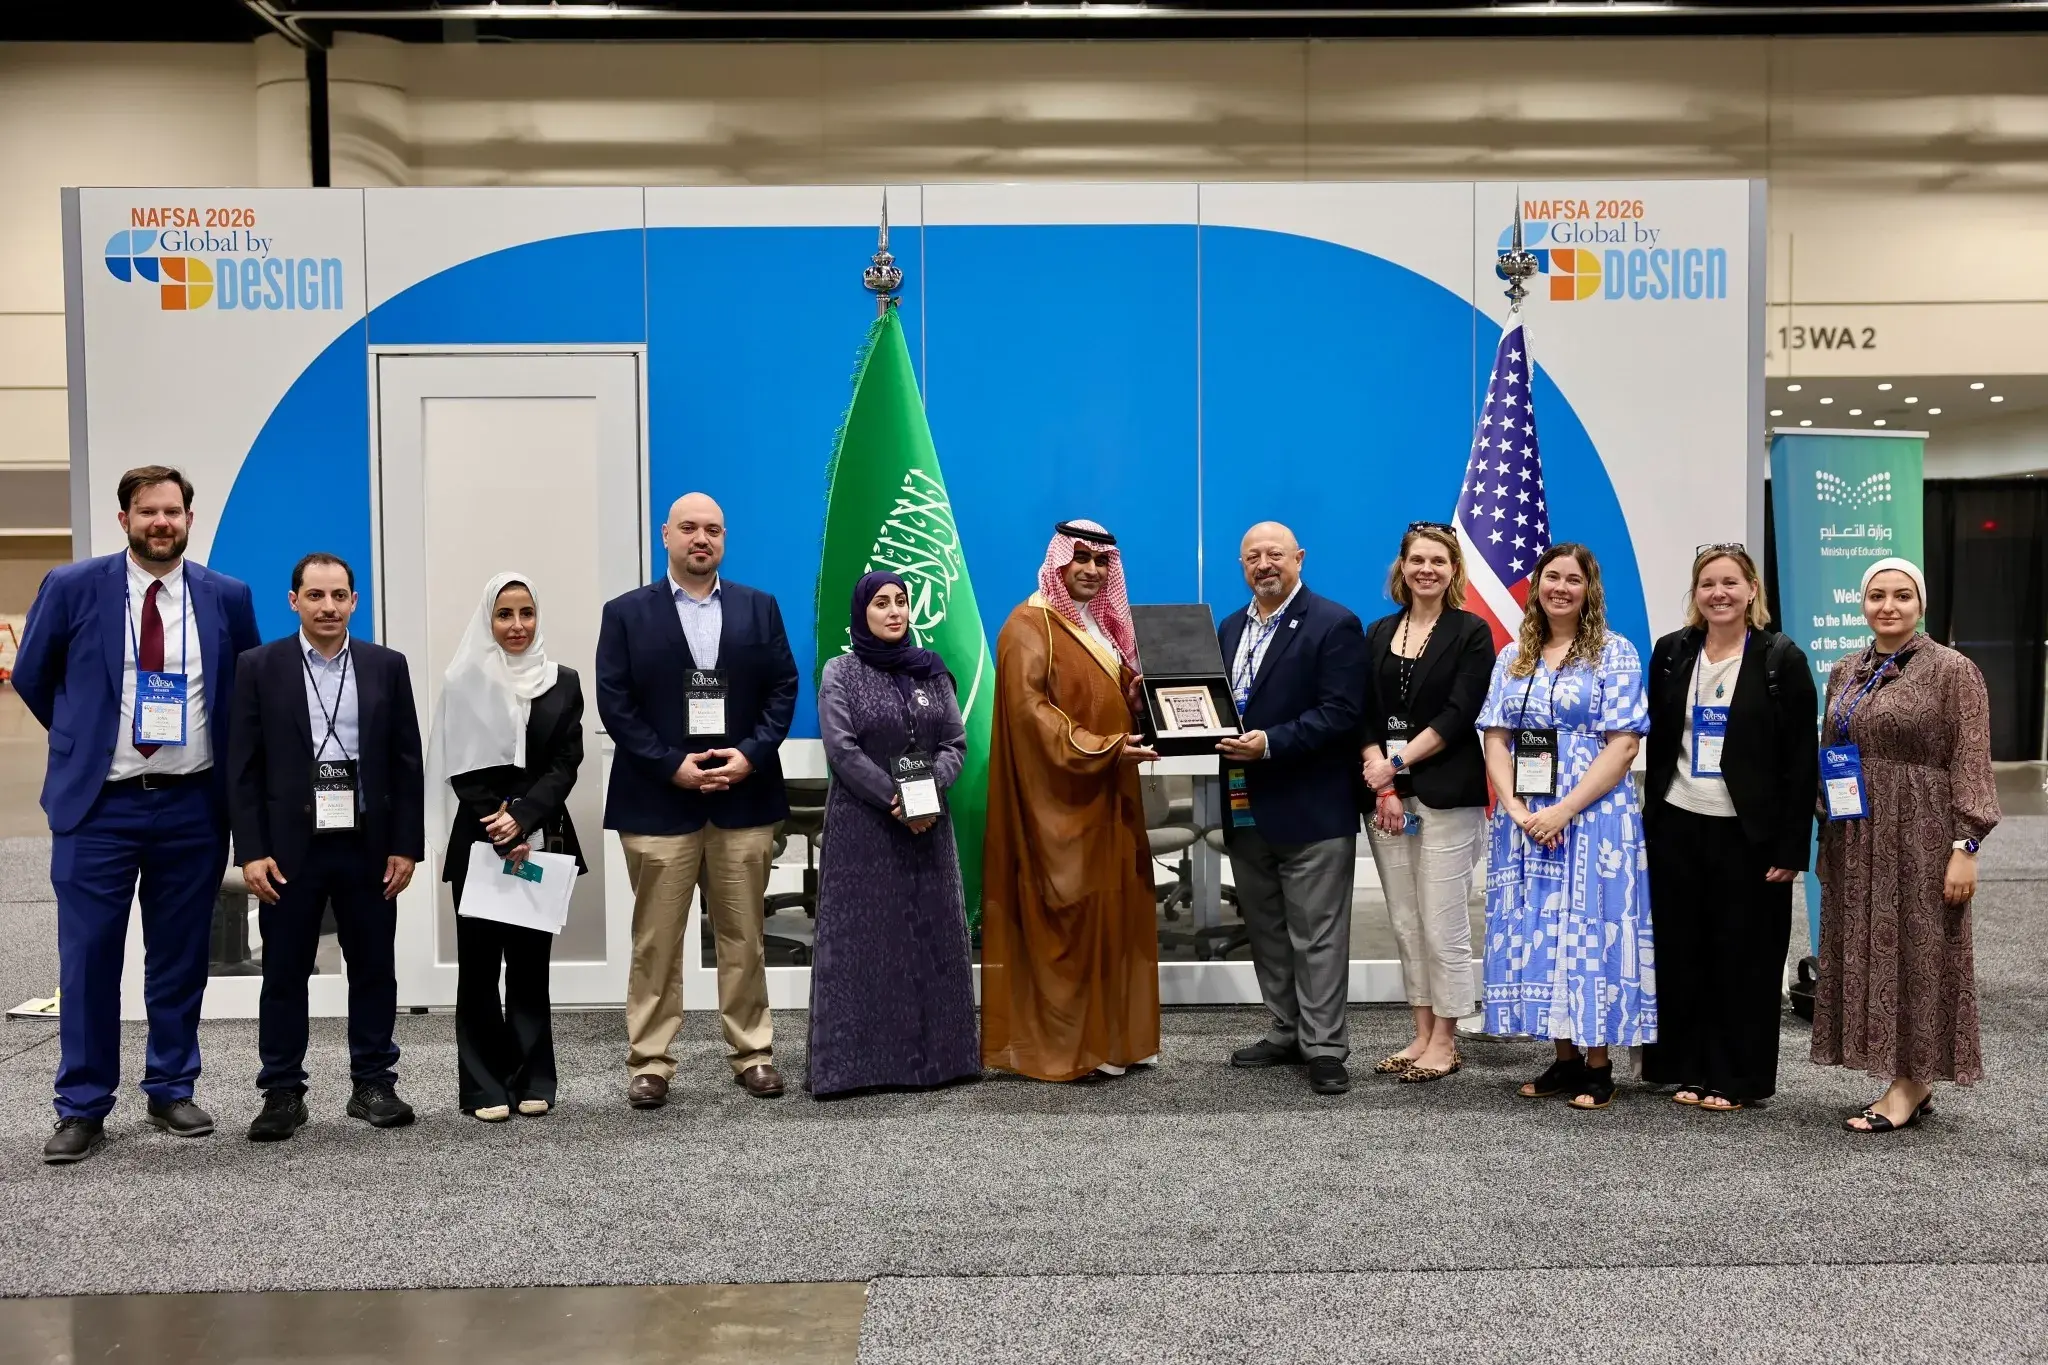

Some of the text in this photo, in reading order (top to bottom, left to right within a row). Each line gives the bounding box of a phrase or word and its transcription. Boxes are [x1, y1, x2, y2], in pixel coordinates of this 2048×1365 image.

[1524, 199, 1644, 219] NAFSA 2026
[131, 207, 255, 228] NAFSA 2026
[1551, 221, 1660, 249] Global by
[159, 230, 272, 258] Global by
[1867, 523, 1893, 540] وزارة
[1821, 546, 1893, 559] Ministry of Education
[1833, 588, 1861, 603] Welc
[1813, 613, 1868, 627] to the Meeti
[1810, 637, 1822, 650] of
[1824, 636, 1838, 649] the
[1839, 635, 1866, 649] Saudi
[148, 677, 175, 688] NAFSA
[692, 676, 718, 686] NAFSA
[1703, 711, 1727, 721] NAFSA
[1388, 719, 1407, 729] NAFS
[1522, 735, 1548, 744] NAFSA
[320, 767, 348, 777] NAFSA
